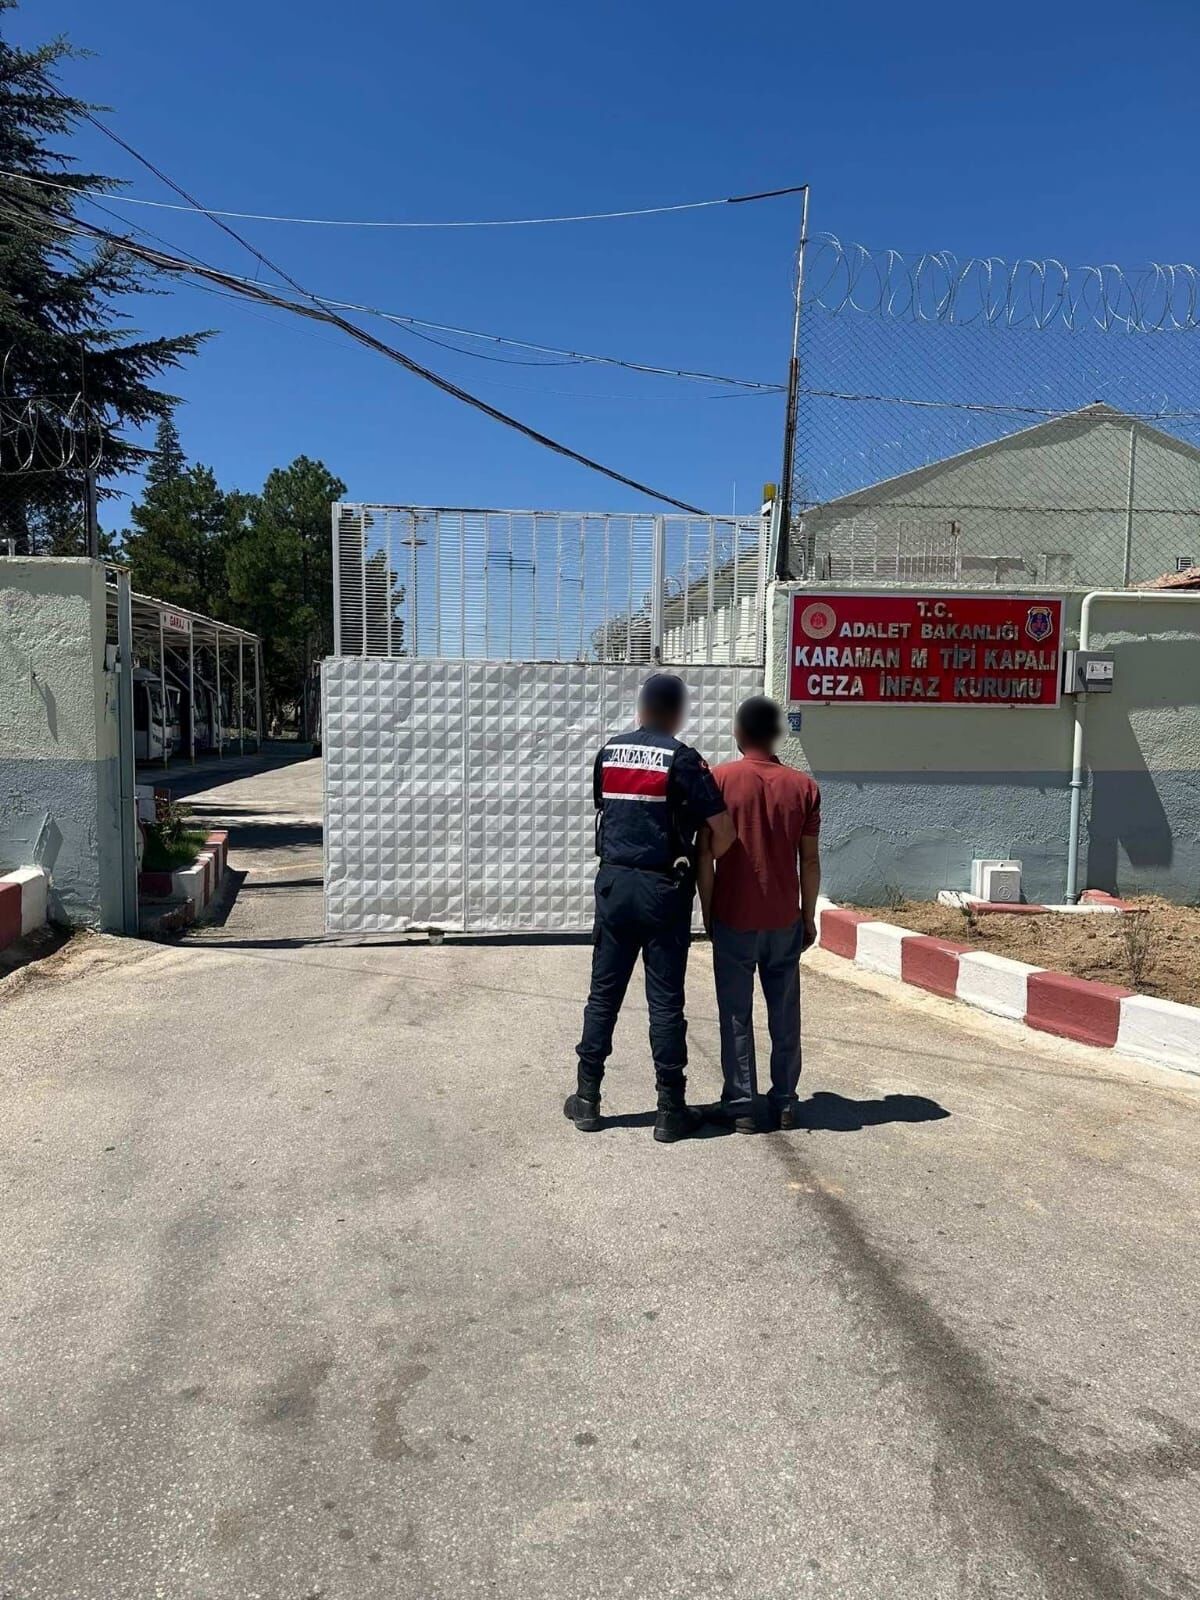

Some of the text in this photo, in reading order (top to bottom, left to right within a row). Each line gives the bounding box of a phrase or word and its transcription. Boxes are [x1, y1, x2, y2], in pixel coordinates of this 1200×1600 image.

[916, 601, 953, 618] T.C.
[839, 621, 1019, 641] ADALET BAKANLIĞI
[795, 644, 1056, 671] KARAMAN M TİPİ KAPALI
[807, 671, 1042, 699] CEZA İNFAZ KURUMU
[608, 748, 664, 767] JANDARMA
